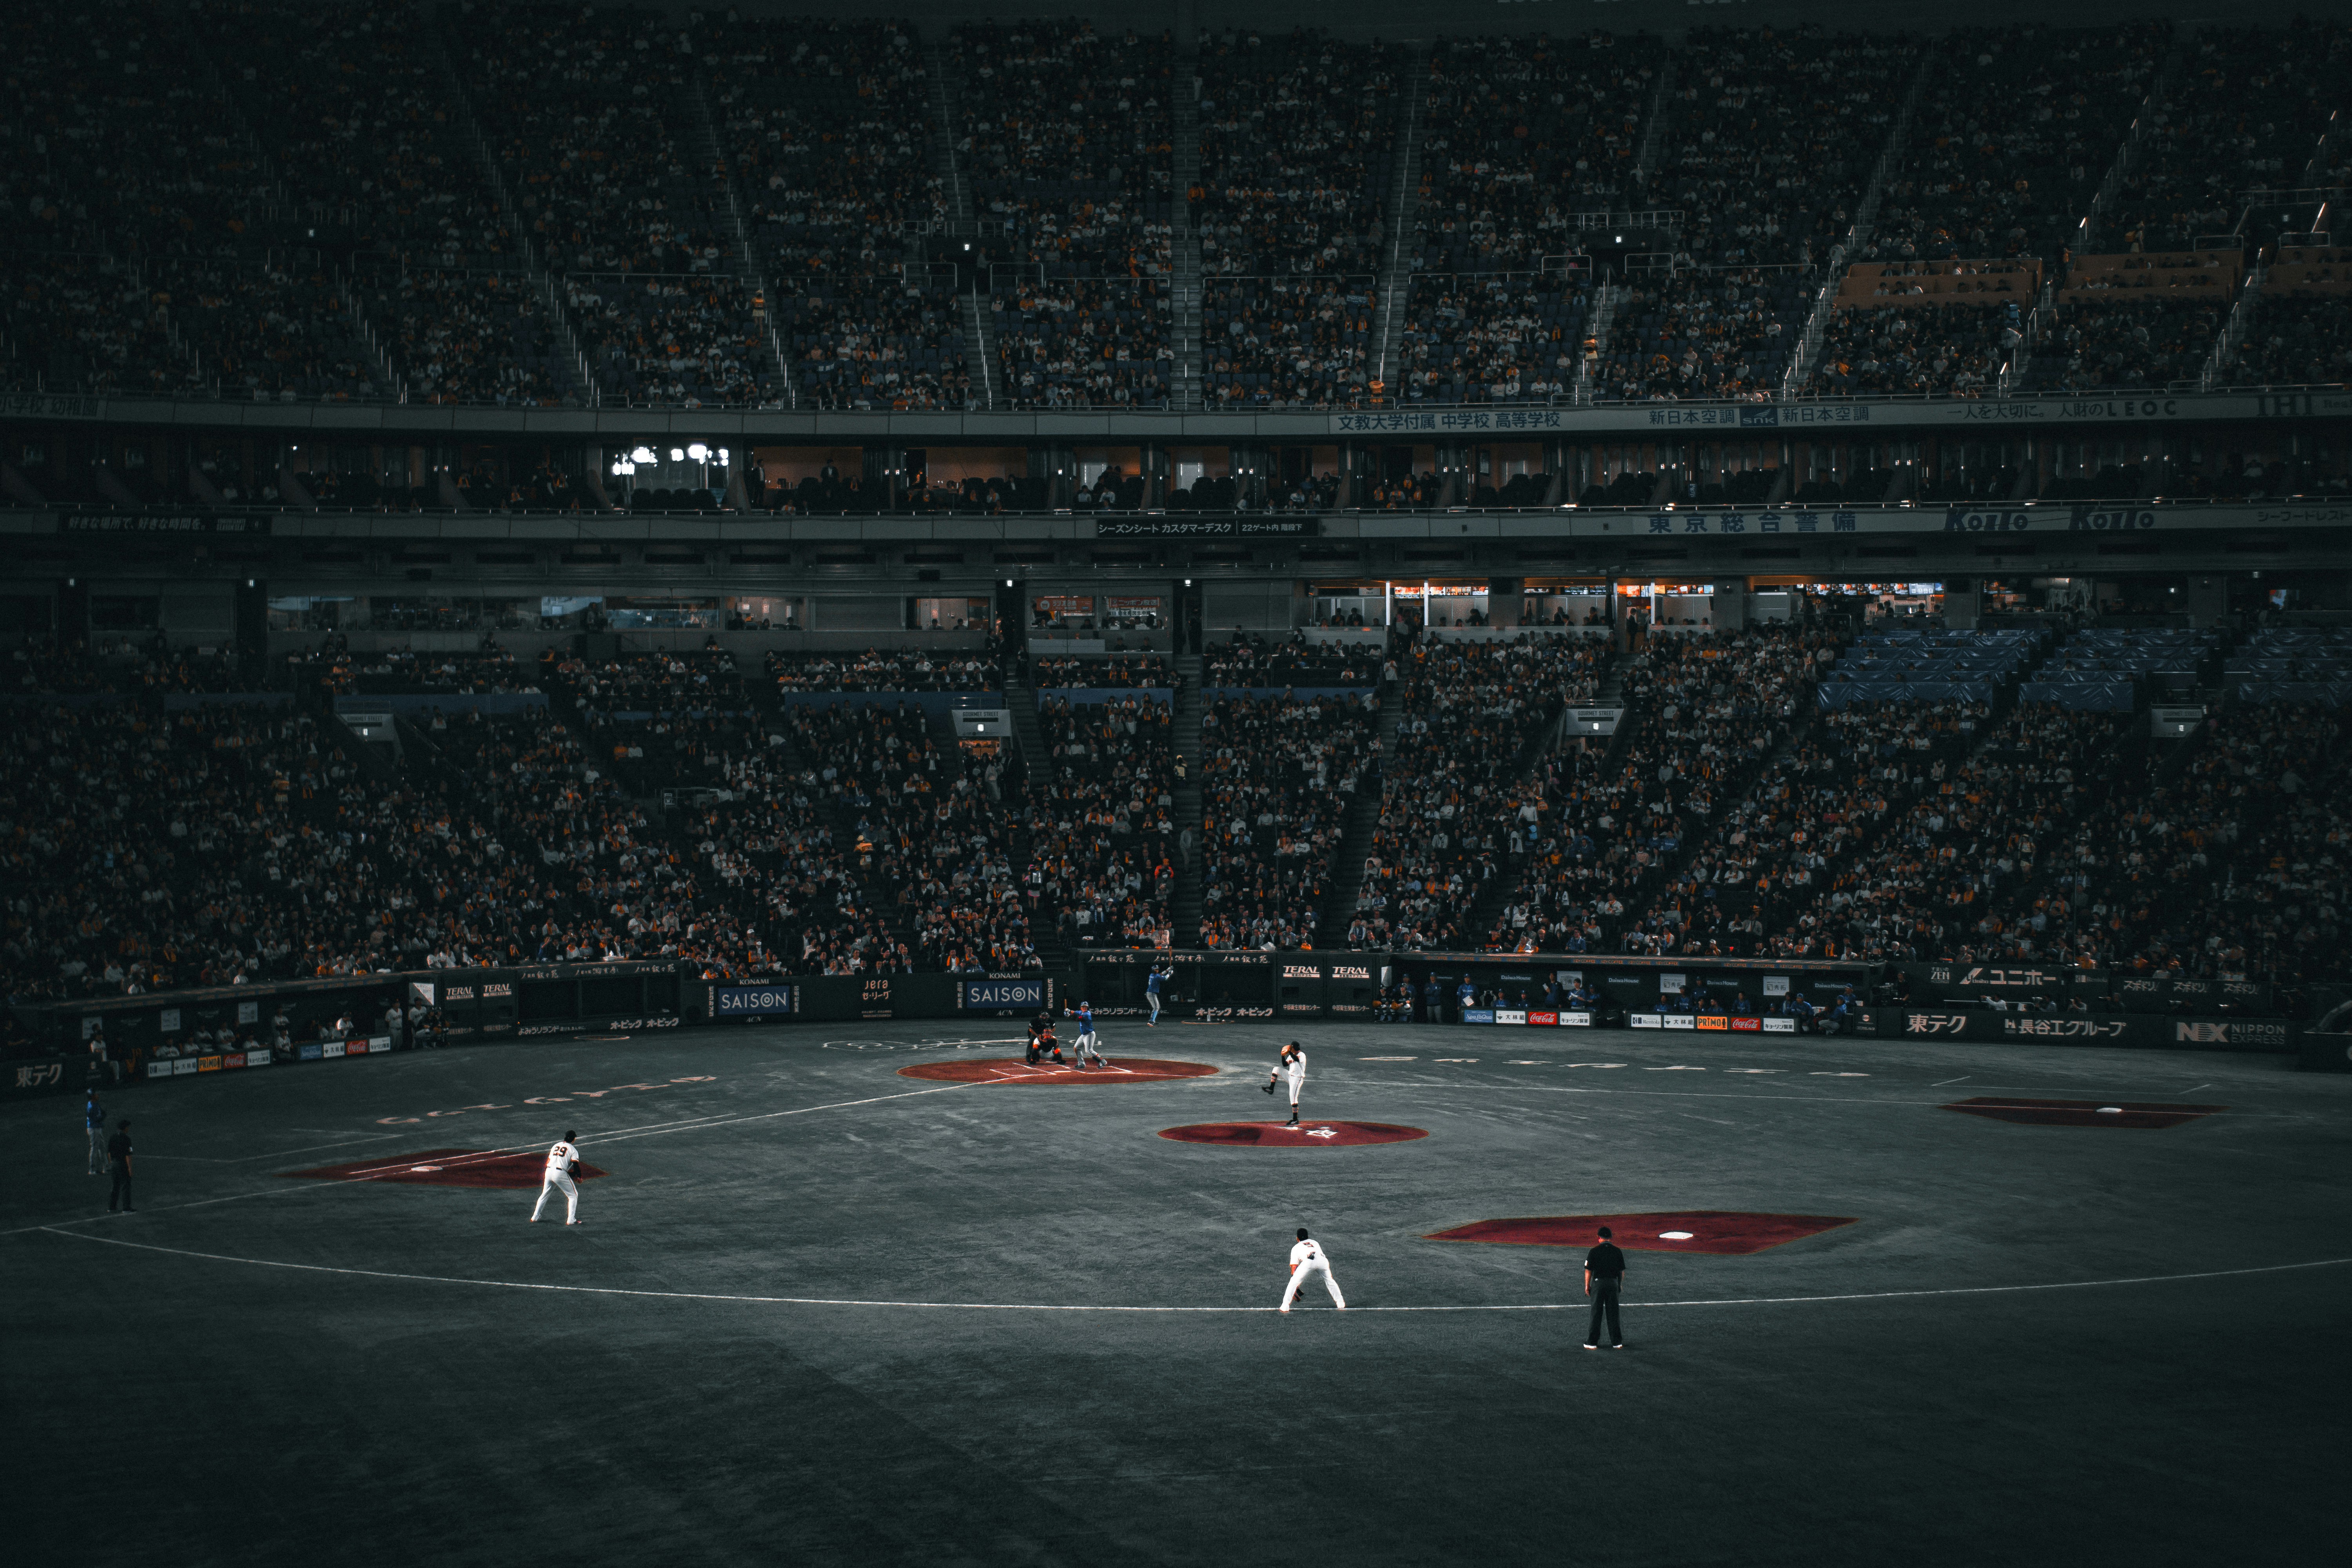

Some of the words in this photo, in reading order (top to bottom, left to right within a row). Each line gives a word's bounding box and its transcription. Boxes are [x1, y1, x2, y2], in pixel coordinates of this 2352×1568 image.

[2256, 394, 2315, 416] IHI
[1338, 414, 1435, 431] 文教大学付属
[1441, 413, 1489, 429] 中学校
[1495, 412, 1560, 428] 高等学校
[1649, 409, 1734, 425] 新日本空調
[1782, 407, 1869, 422] 新日本空調
[1098, 524, 1158, 533] シーズンシート
[1161, 523, 1232, 533] カスタマーデスク
[1648, 511, 1856, 534] 東京総合警備
[1283, 965, 1320, 974] TERAL
[1332, 966, 1369, 975] TERAL
[1931, 971, 1949, 980] ZEN
[1990, 969, 2056, 985] ユニホー
[446, 986, 474, 996] TERAL
[483, 983, 512, 993] TERAL
[971, 987, 1039, 1002] SAISON
[721, 992, 786, 1009] SAISON
[518, 1025, 559, 1035] よみうりランド
[1906, 1014, 1967, 1033] 東テク
[2018, 1019, 2127, 1036] 長谷工グループ
[2231, 1024, 2286, 1034] NIPPON
[2231, 1034, 2285, 1044] EXPRESS
[15, 1063, 62, 1087] 東テク
[553, 1146, 568, 1157] 29
